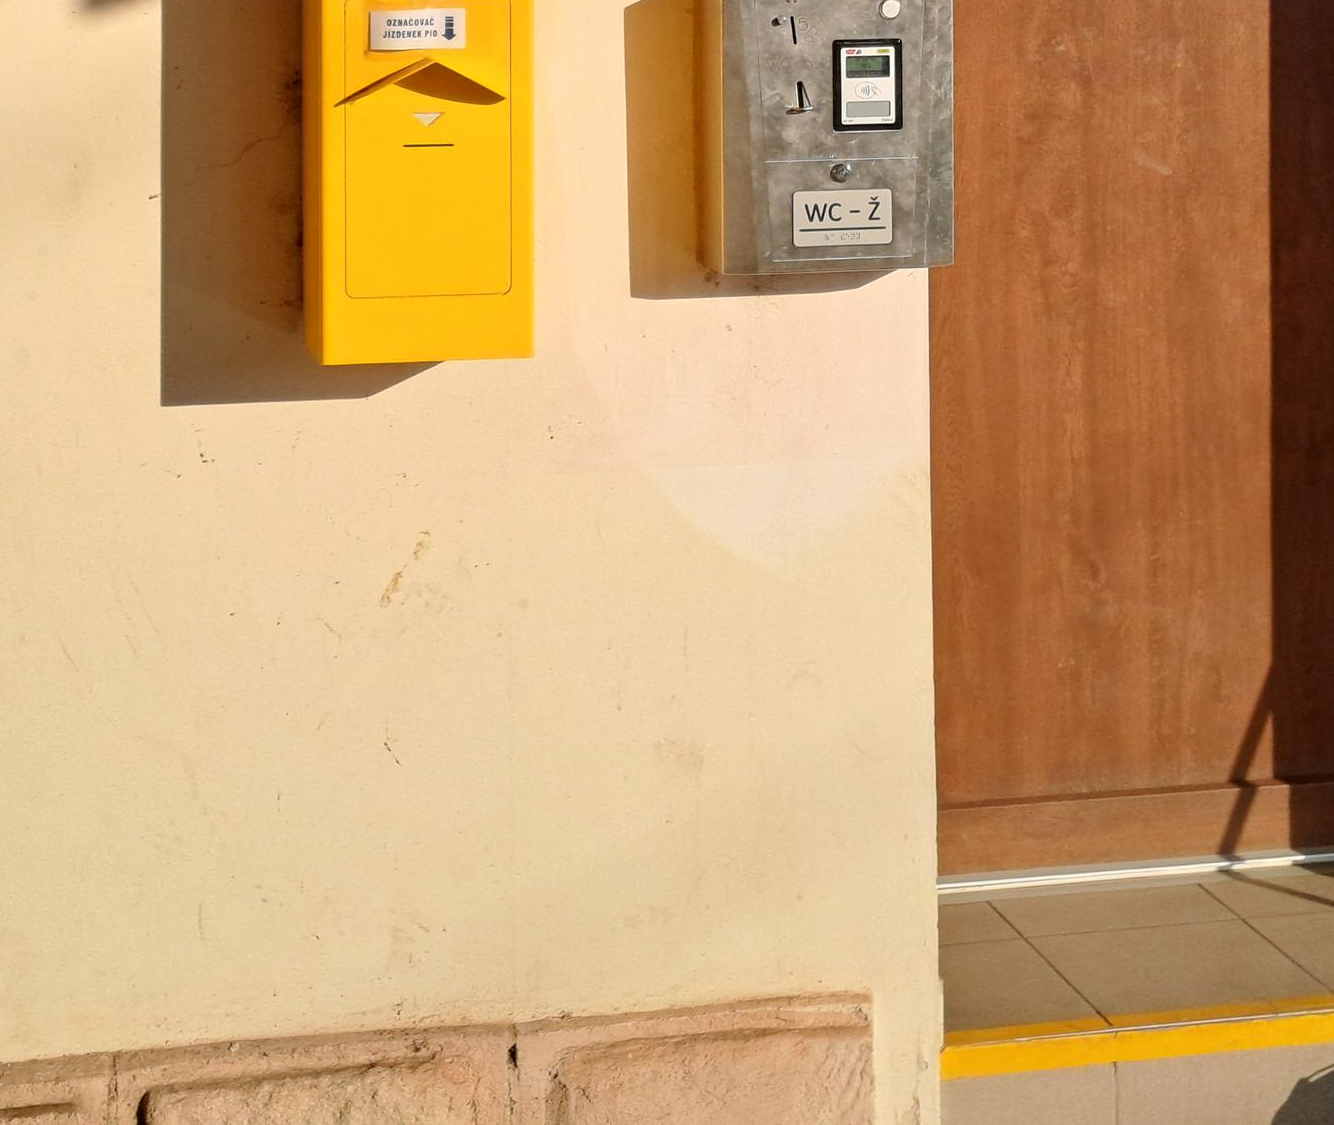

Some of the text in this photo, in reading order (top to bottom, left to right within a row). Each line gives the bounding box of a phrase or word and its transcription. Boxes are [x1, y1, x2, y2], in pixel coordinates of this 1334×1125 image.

[386, 17, 435, 27] OZNAČOVAČ
[382, 28, 438, 39] JÍZDENEK PID
[804, 202, 842, 223] WC
[868, 195, 881, 221] Ž
